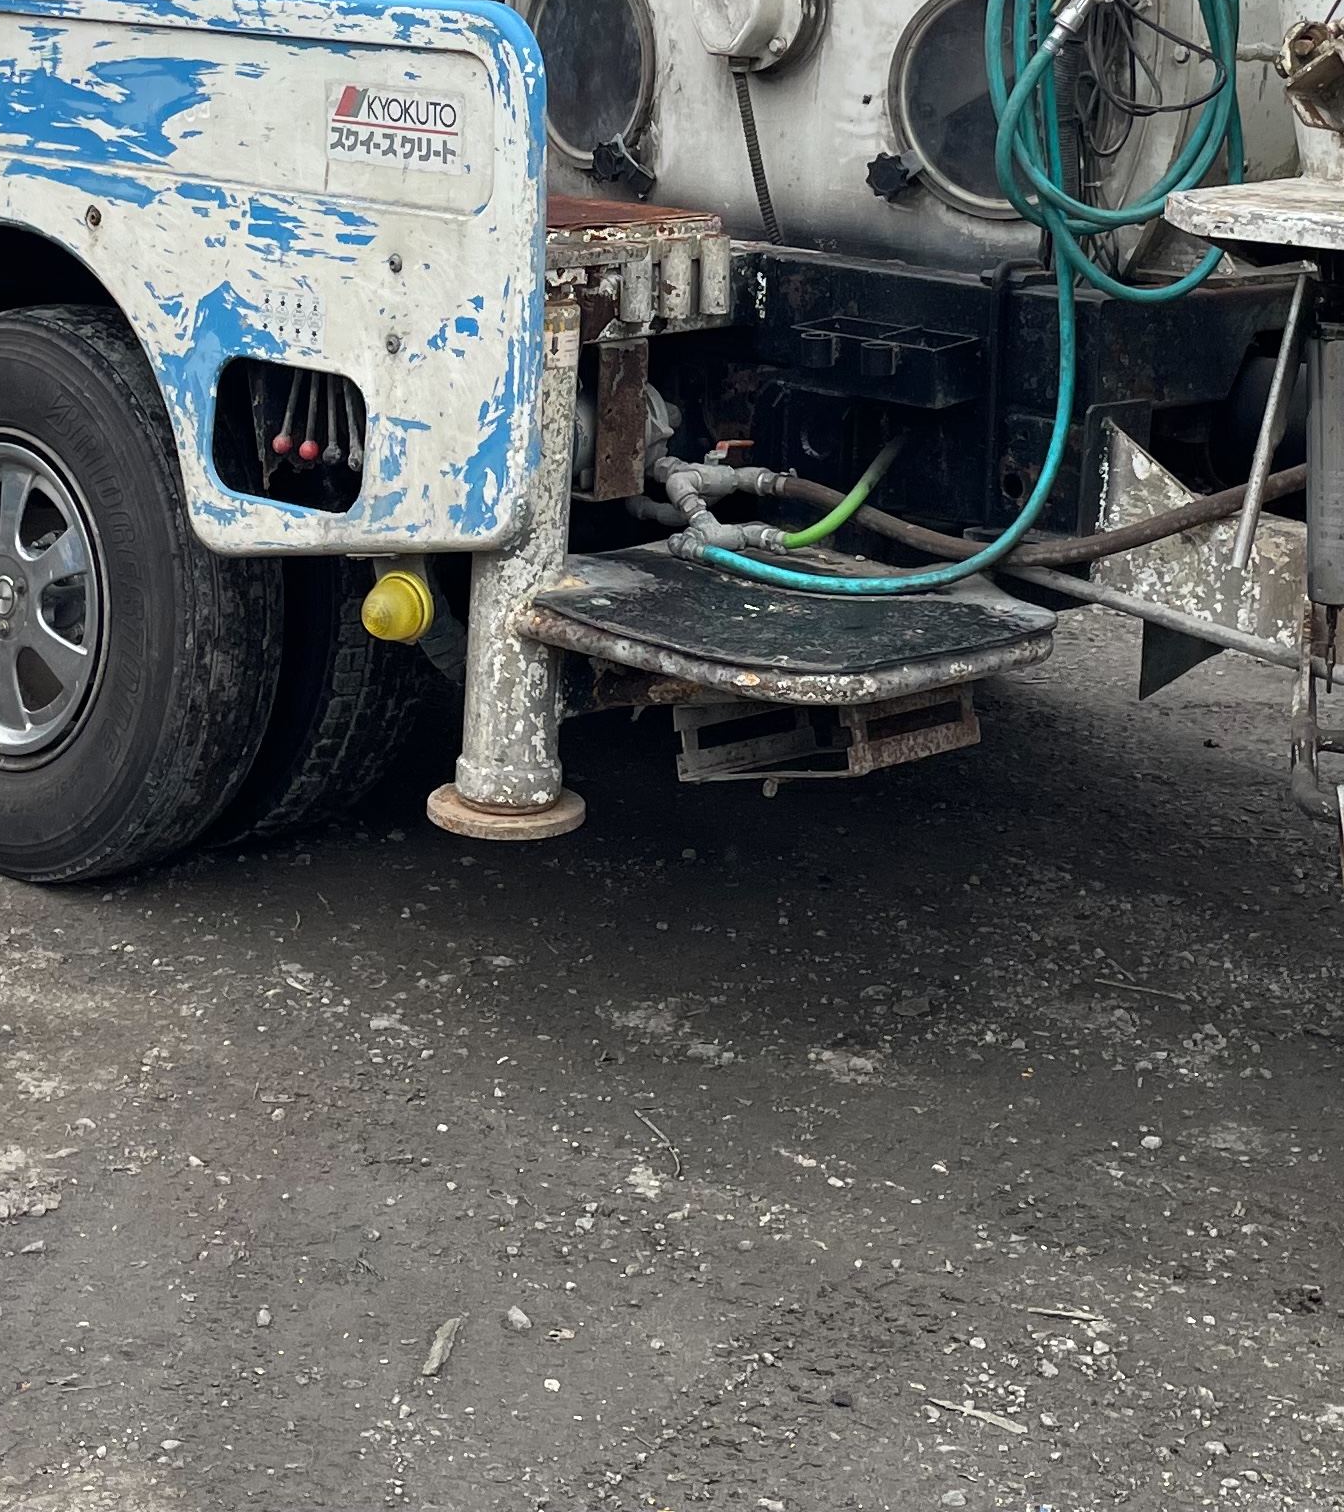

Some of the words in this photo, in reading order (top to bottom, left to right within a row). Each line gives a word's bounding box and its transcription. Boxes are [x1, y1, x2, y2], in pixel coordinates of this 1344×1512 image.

[367, 94, 457, 128] KYOKUTO
[329, 126, 457, 165] スクイーズクリート
[45, 392, 146, 765] BRIDGESTONE
